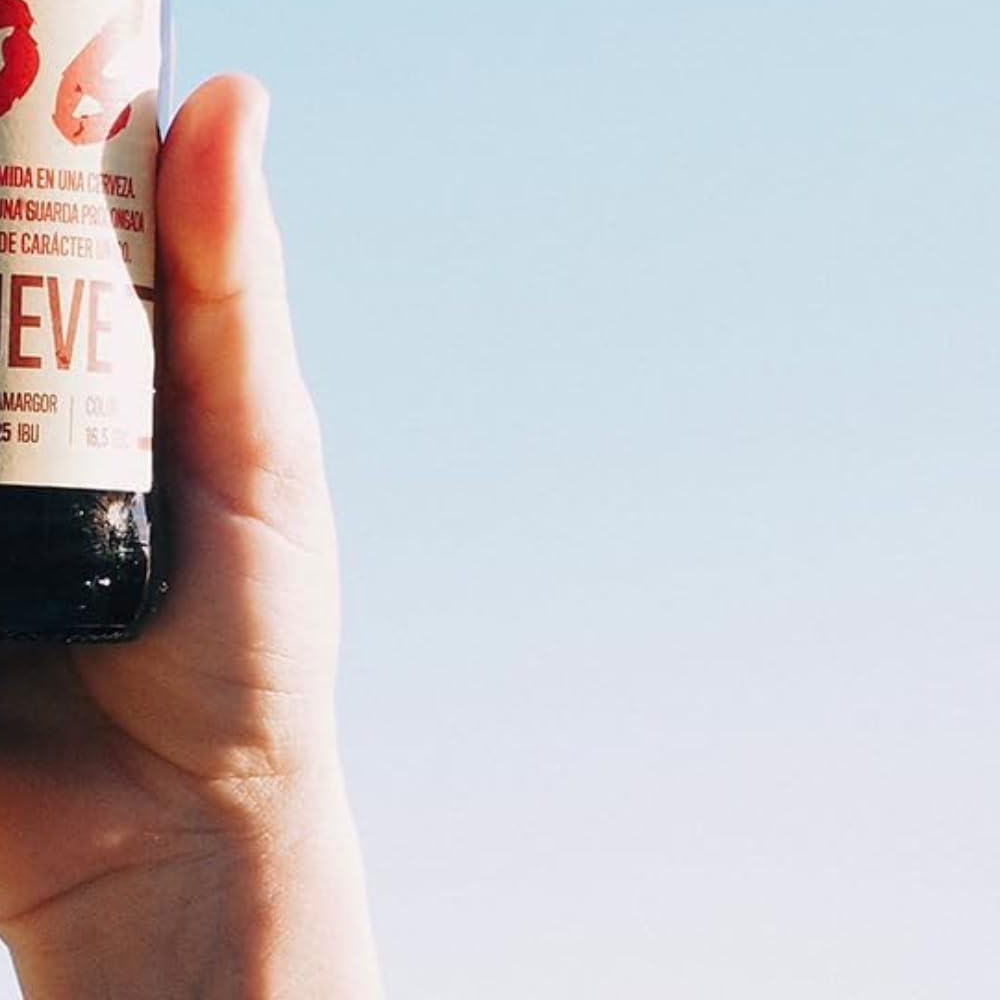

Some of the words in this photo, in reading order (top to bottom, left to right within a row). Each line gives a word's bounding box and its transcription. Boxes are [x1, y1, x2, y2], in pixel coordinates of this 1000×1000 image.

[37, 168, 54, 189] EN
[59, 170, 84, 192] UNA
[26, 200, 79, 224] GUARDA
[0, 231, 16, 254] DE
[21, 231, 93, 259] CARÁCTER
[17, 423, 40, 443] IBU
